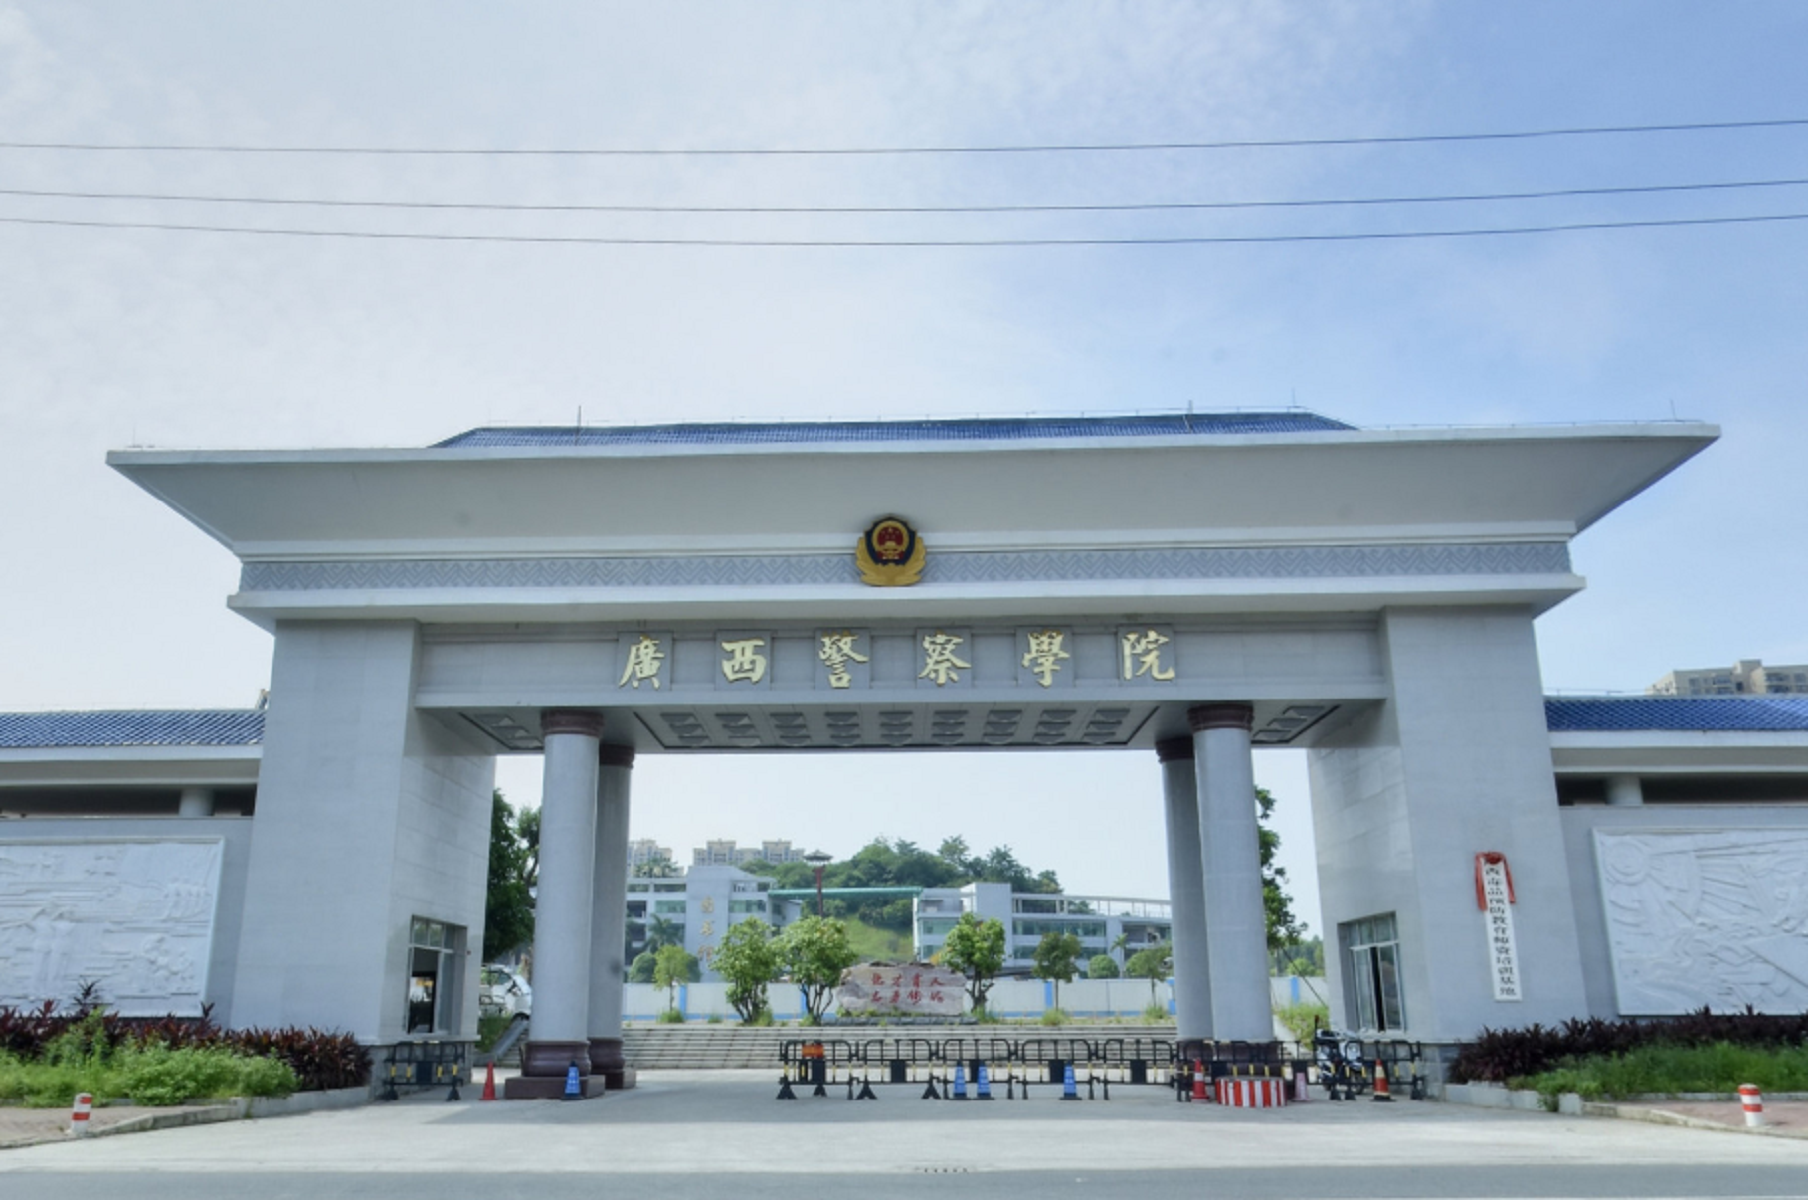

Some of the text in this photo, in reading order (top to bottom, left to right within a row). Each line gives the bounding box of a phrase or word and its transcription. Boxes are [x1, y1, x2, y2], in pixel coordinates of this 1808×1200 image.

[619, 629, 1176, 690] 廣西警察學院
[1484, 857, 1518, 997] 西毒品预防教育师资培训基地
